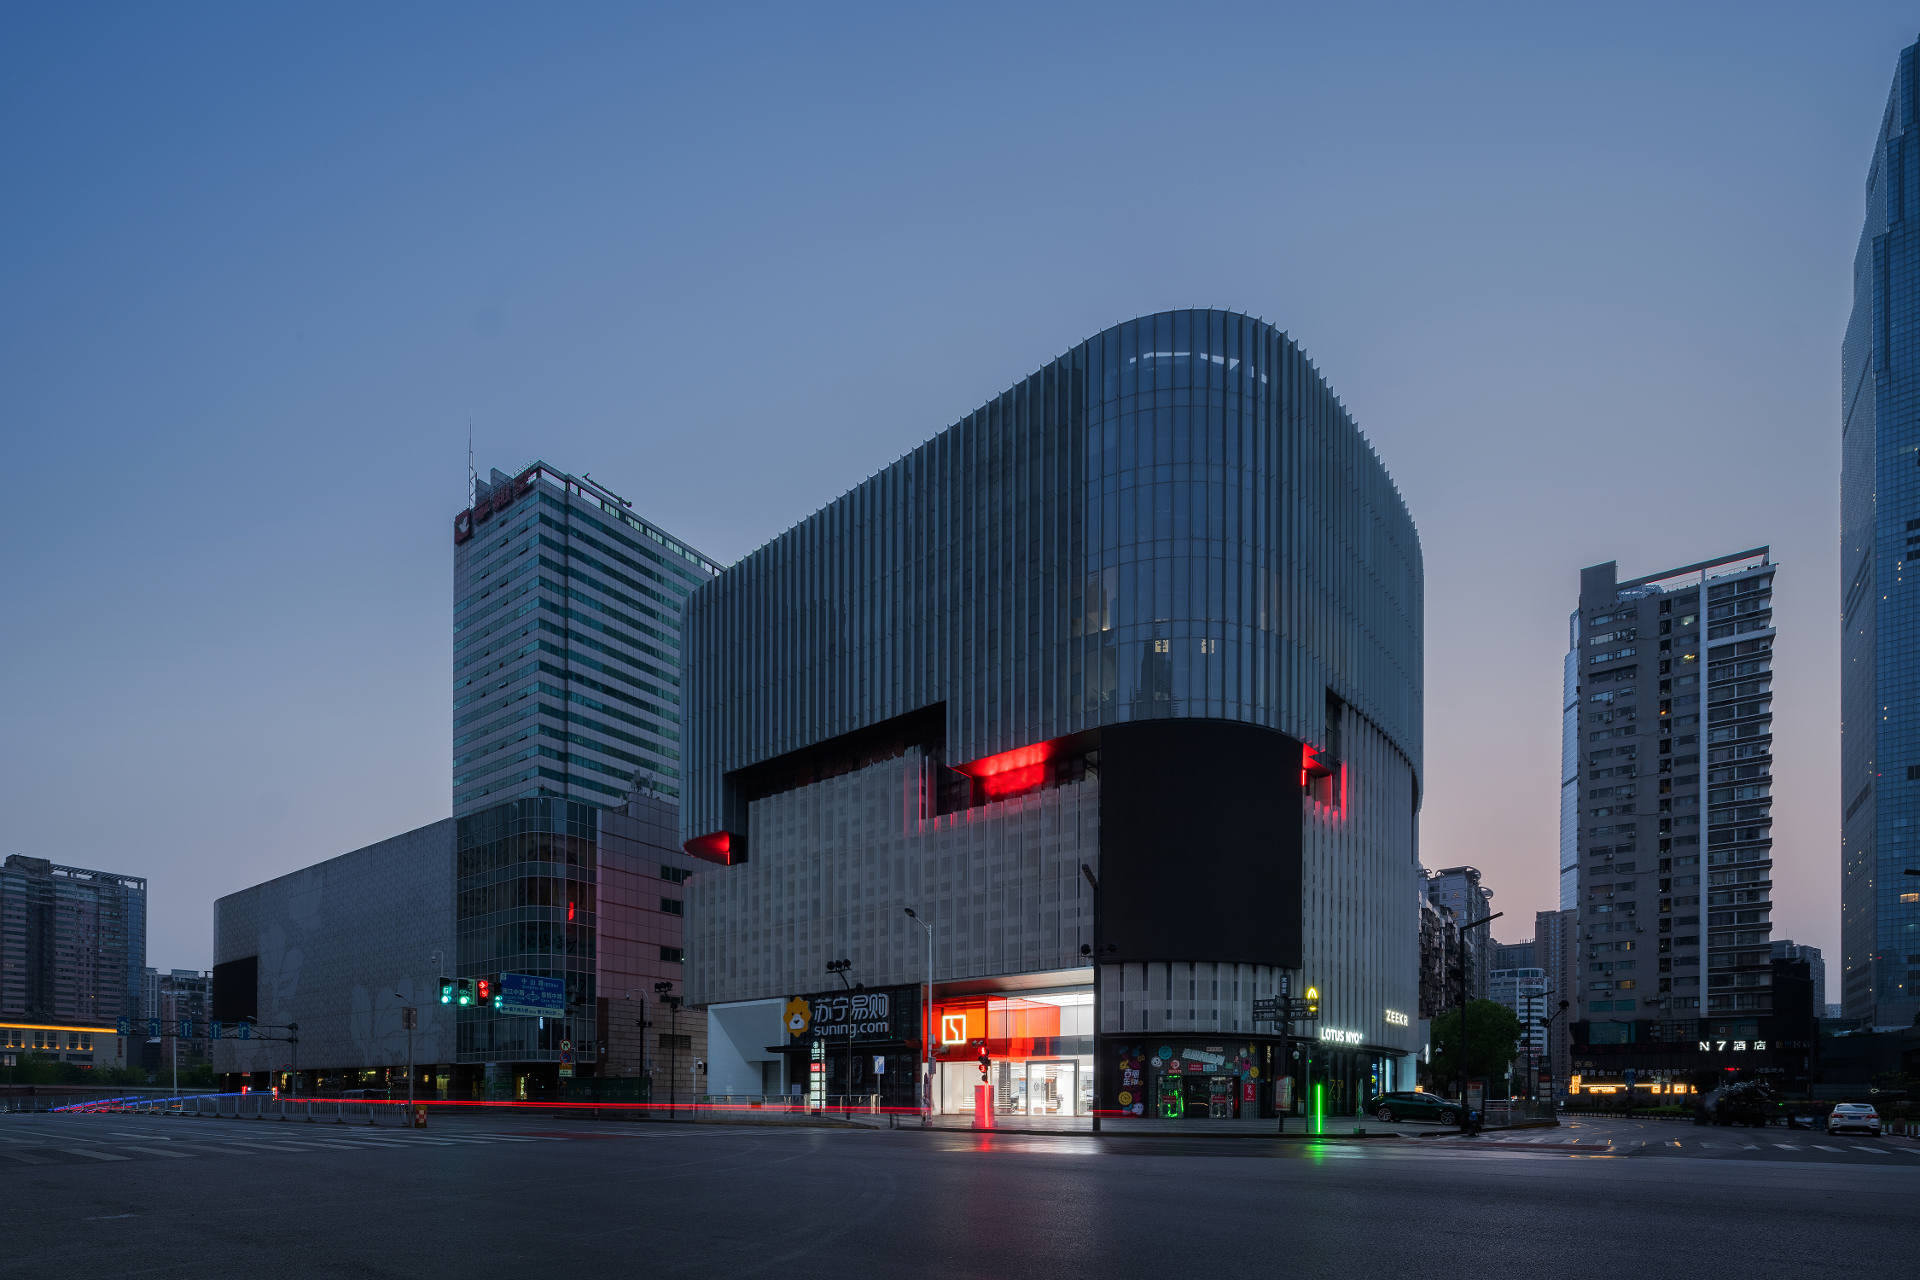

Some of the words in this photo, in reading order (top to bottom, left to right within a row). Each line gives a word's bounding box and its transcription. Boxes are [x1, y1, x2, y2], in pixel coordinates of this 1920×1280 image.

[814, 993, 889, 1023] 苏宁易购
[1386, 1009, 1408, 1026] ZEEKR
[814, 1021, 889, 1038] suning.com
[1321, 1028, 1344, 1042] LOTUS
